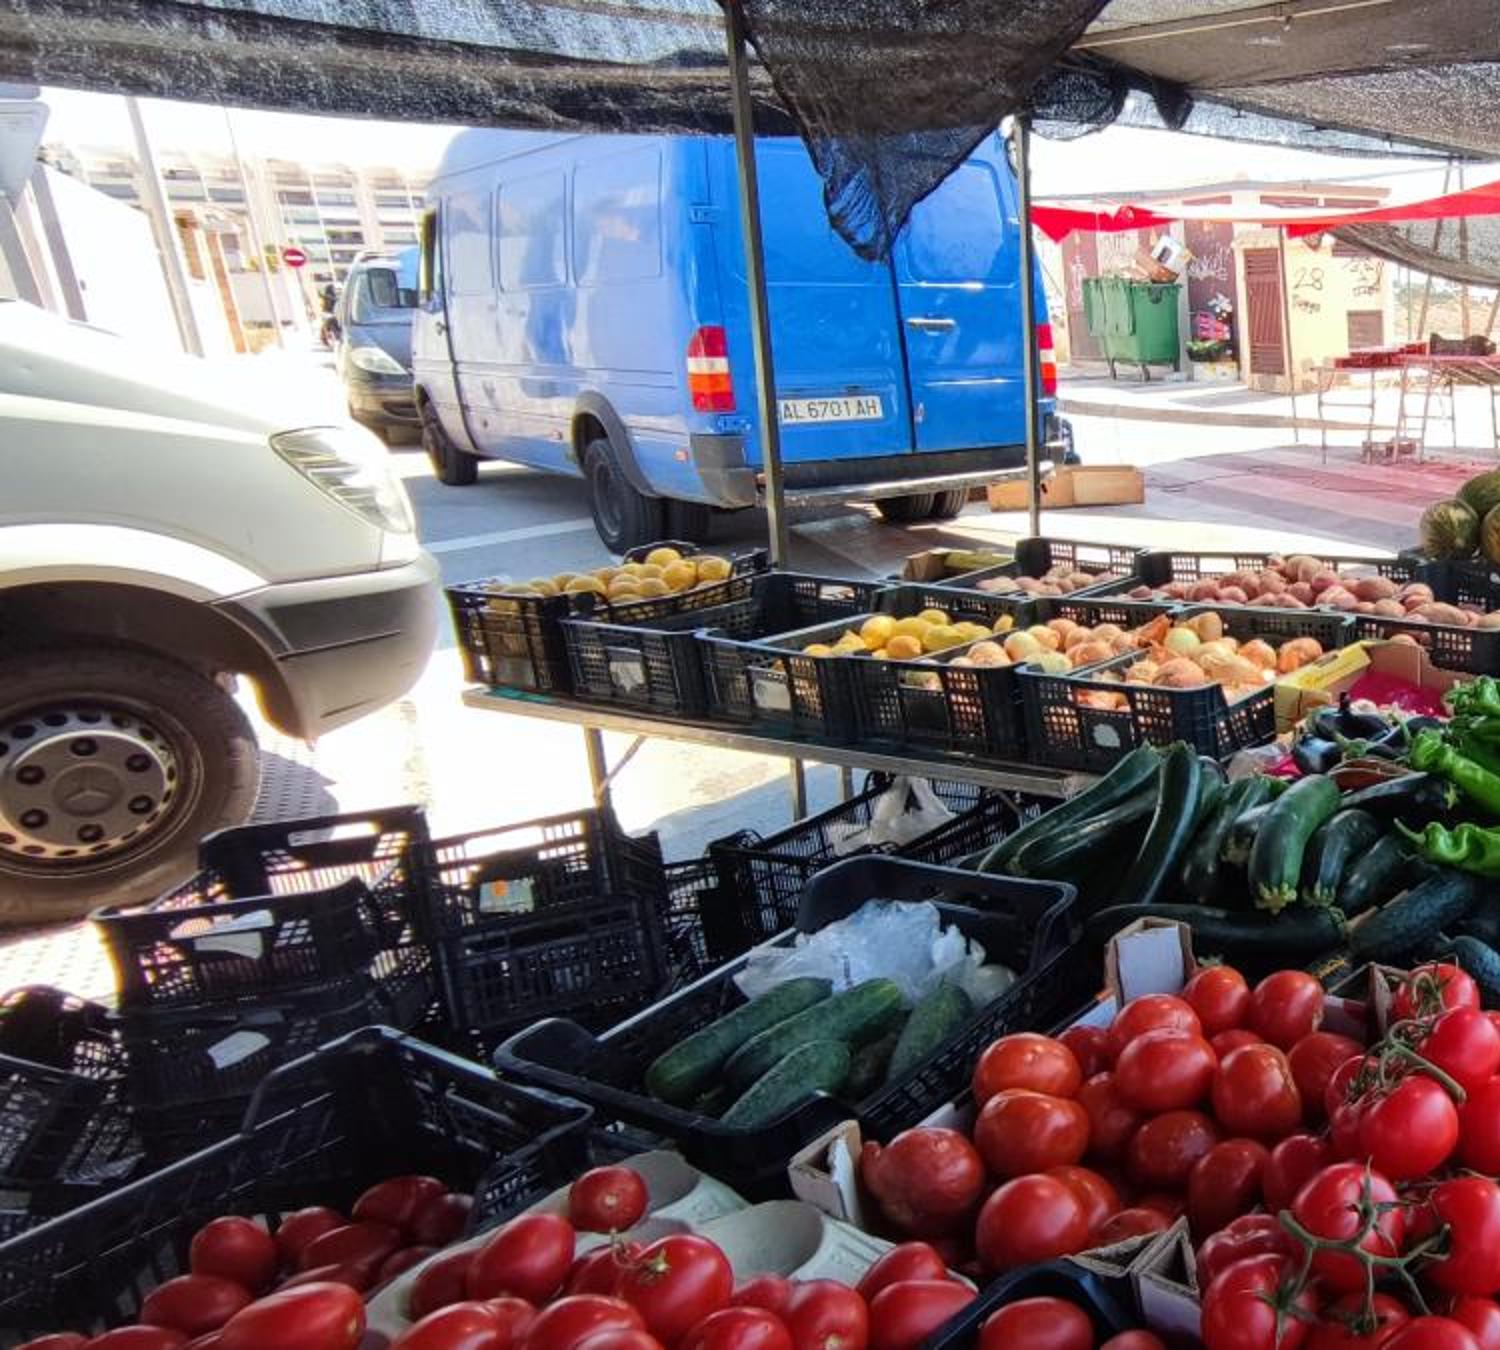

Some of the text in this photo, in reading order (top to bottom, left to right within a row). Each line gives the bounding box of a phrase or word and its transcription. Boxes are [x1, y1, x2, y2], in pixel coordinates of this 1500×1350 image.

[1294, 266, 1324, 290] 28
[783, 399, 878, 419] AL 6701 AH
